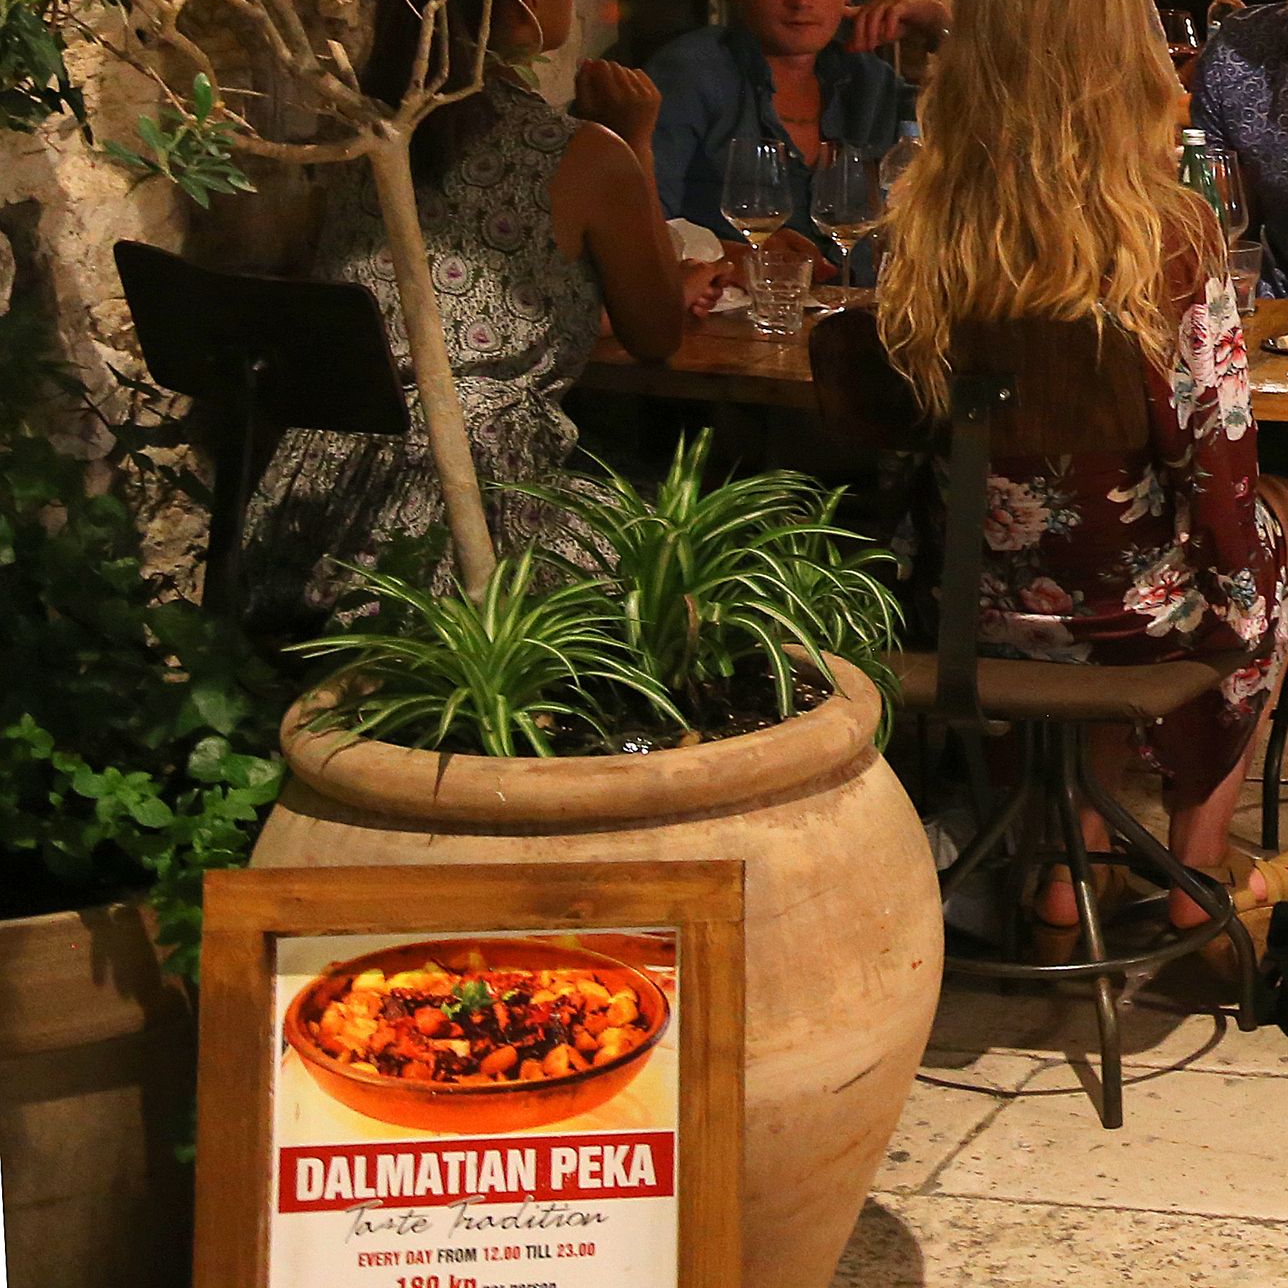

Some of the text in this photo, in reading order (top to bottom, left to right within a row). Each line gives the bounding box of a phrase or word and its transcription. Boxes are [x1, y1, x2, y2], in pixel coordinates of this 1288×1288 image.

[295, 1144, 657, 1202] DALMATIAN PEKA
[344, 1194, 609, 1245] Taste Tradition
[357, 1243, 596, 1267] EVERY DAY FROM 12.00 TILL 23.00
